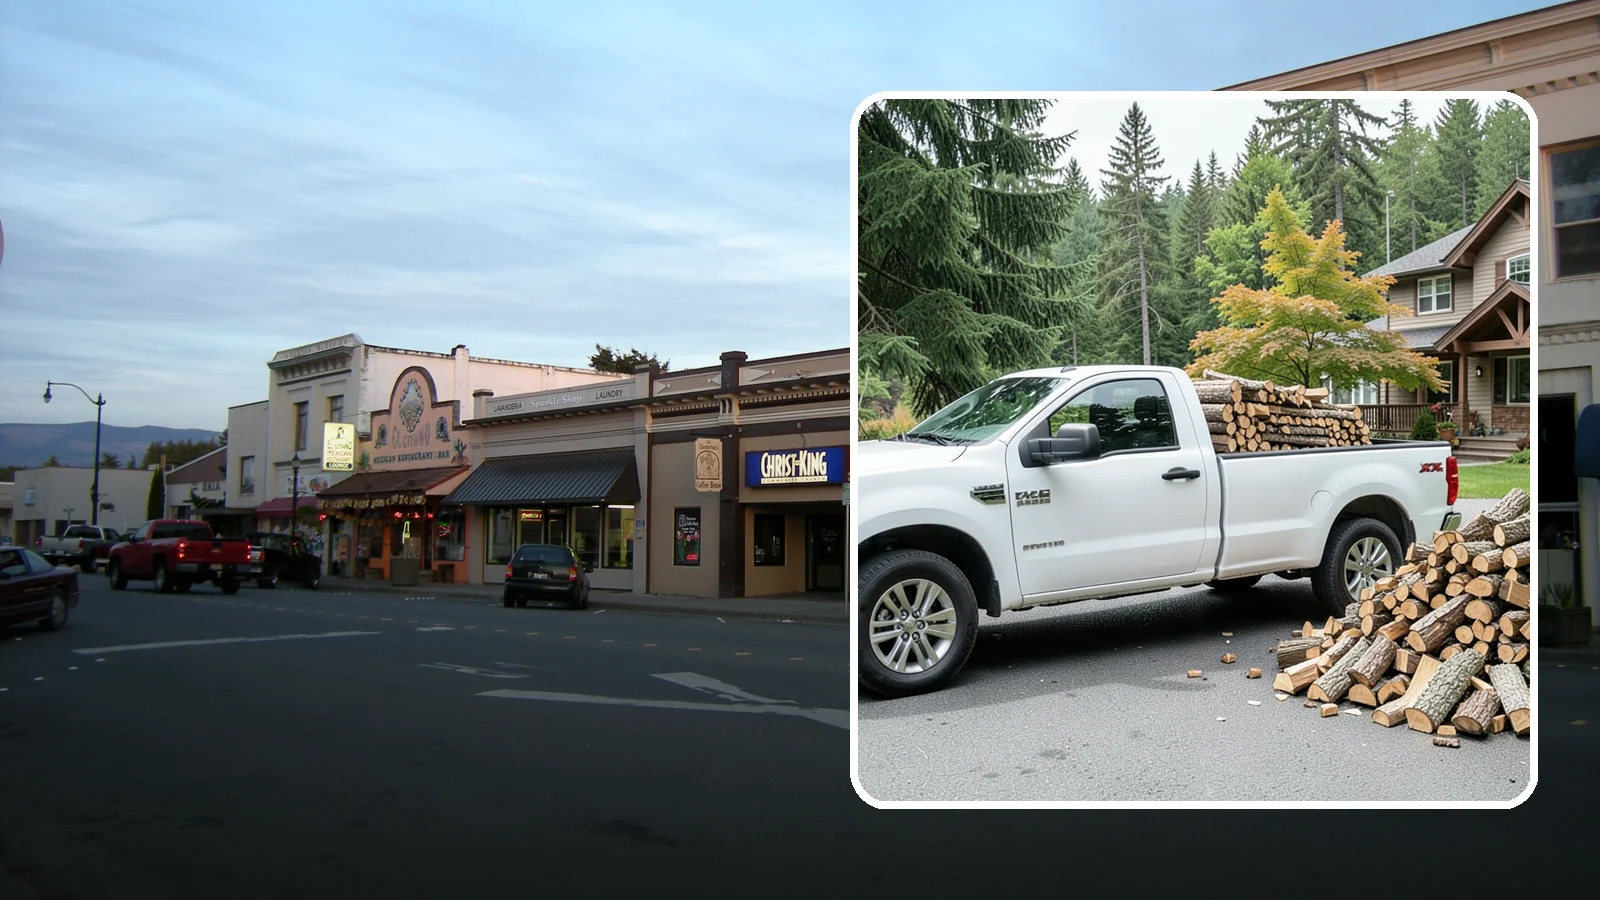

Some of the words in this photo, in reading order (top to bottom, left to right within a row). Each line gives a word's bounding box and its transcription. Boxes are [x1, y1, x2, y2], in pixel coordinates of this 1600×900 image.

[493, 402, 522, 412] LAVANDERIA
[530, 397, 560, 408] Sparkle
[561, 394, 582, 404] Shop
[595, 389, 623, 400] LAUNDRY
[373, 454, 396, 464] MEXICAN
[397, 451, 433, 462] RESTAURANT
[437, 450, 450, 459] BAR
